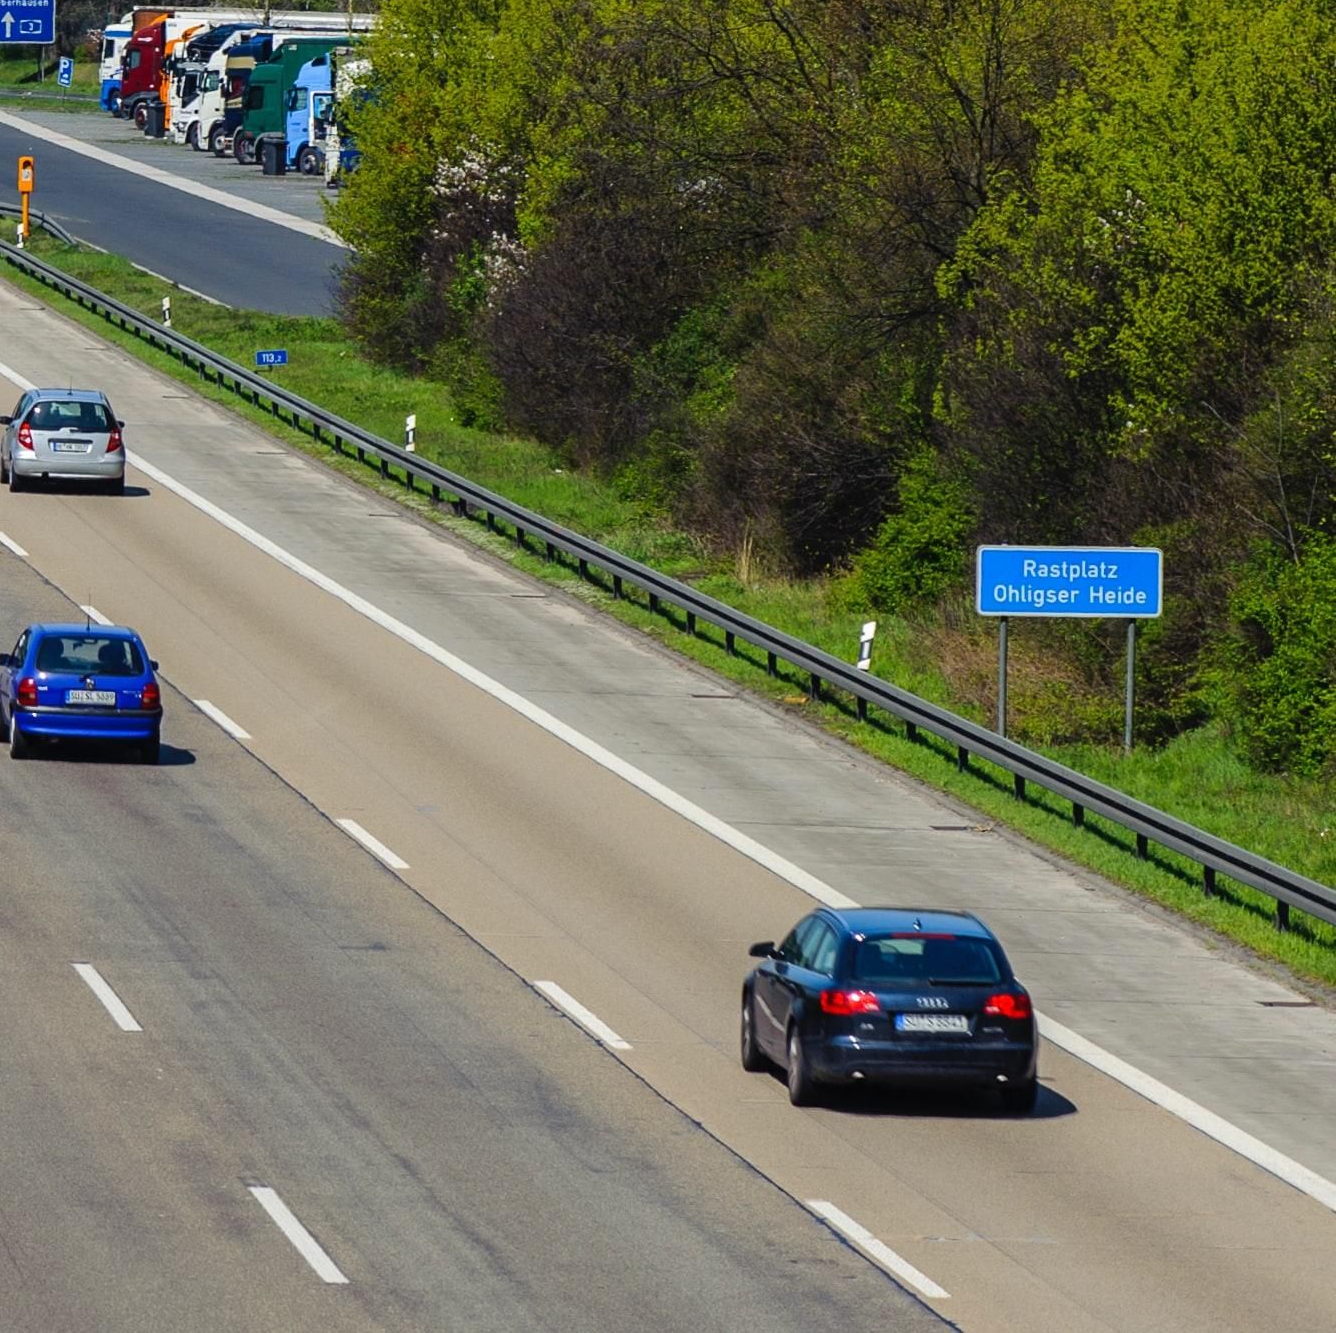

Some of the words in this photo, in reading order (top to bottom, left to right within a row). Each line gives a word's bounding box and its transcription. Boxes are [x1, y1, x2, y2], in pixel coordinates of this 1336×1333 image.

[28, 22, 34, 31] 3
[1023, 559, 1118, 583] Rastplatz
[993, 584, 1079, 608] Ohligser
[1089, 586, 1147, 604] Heide
